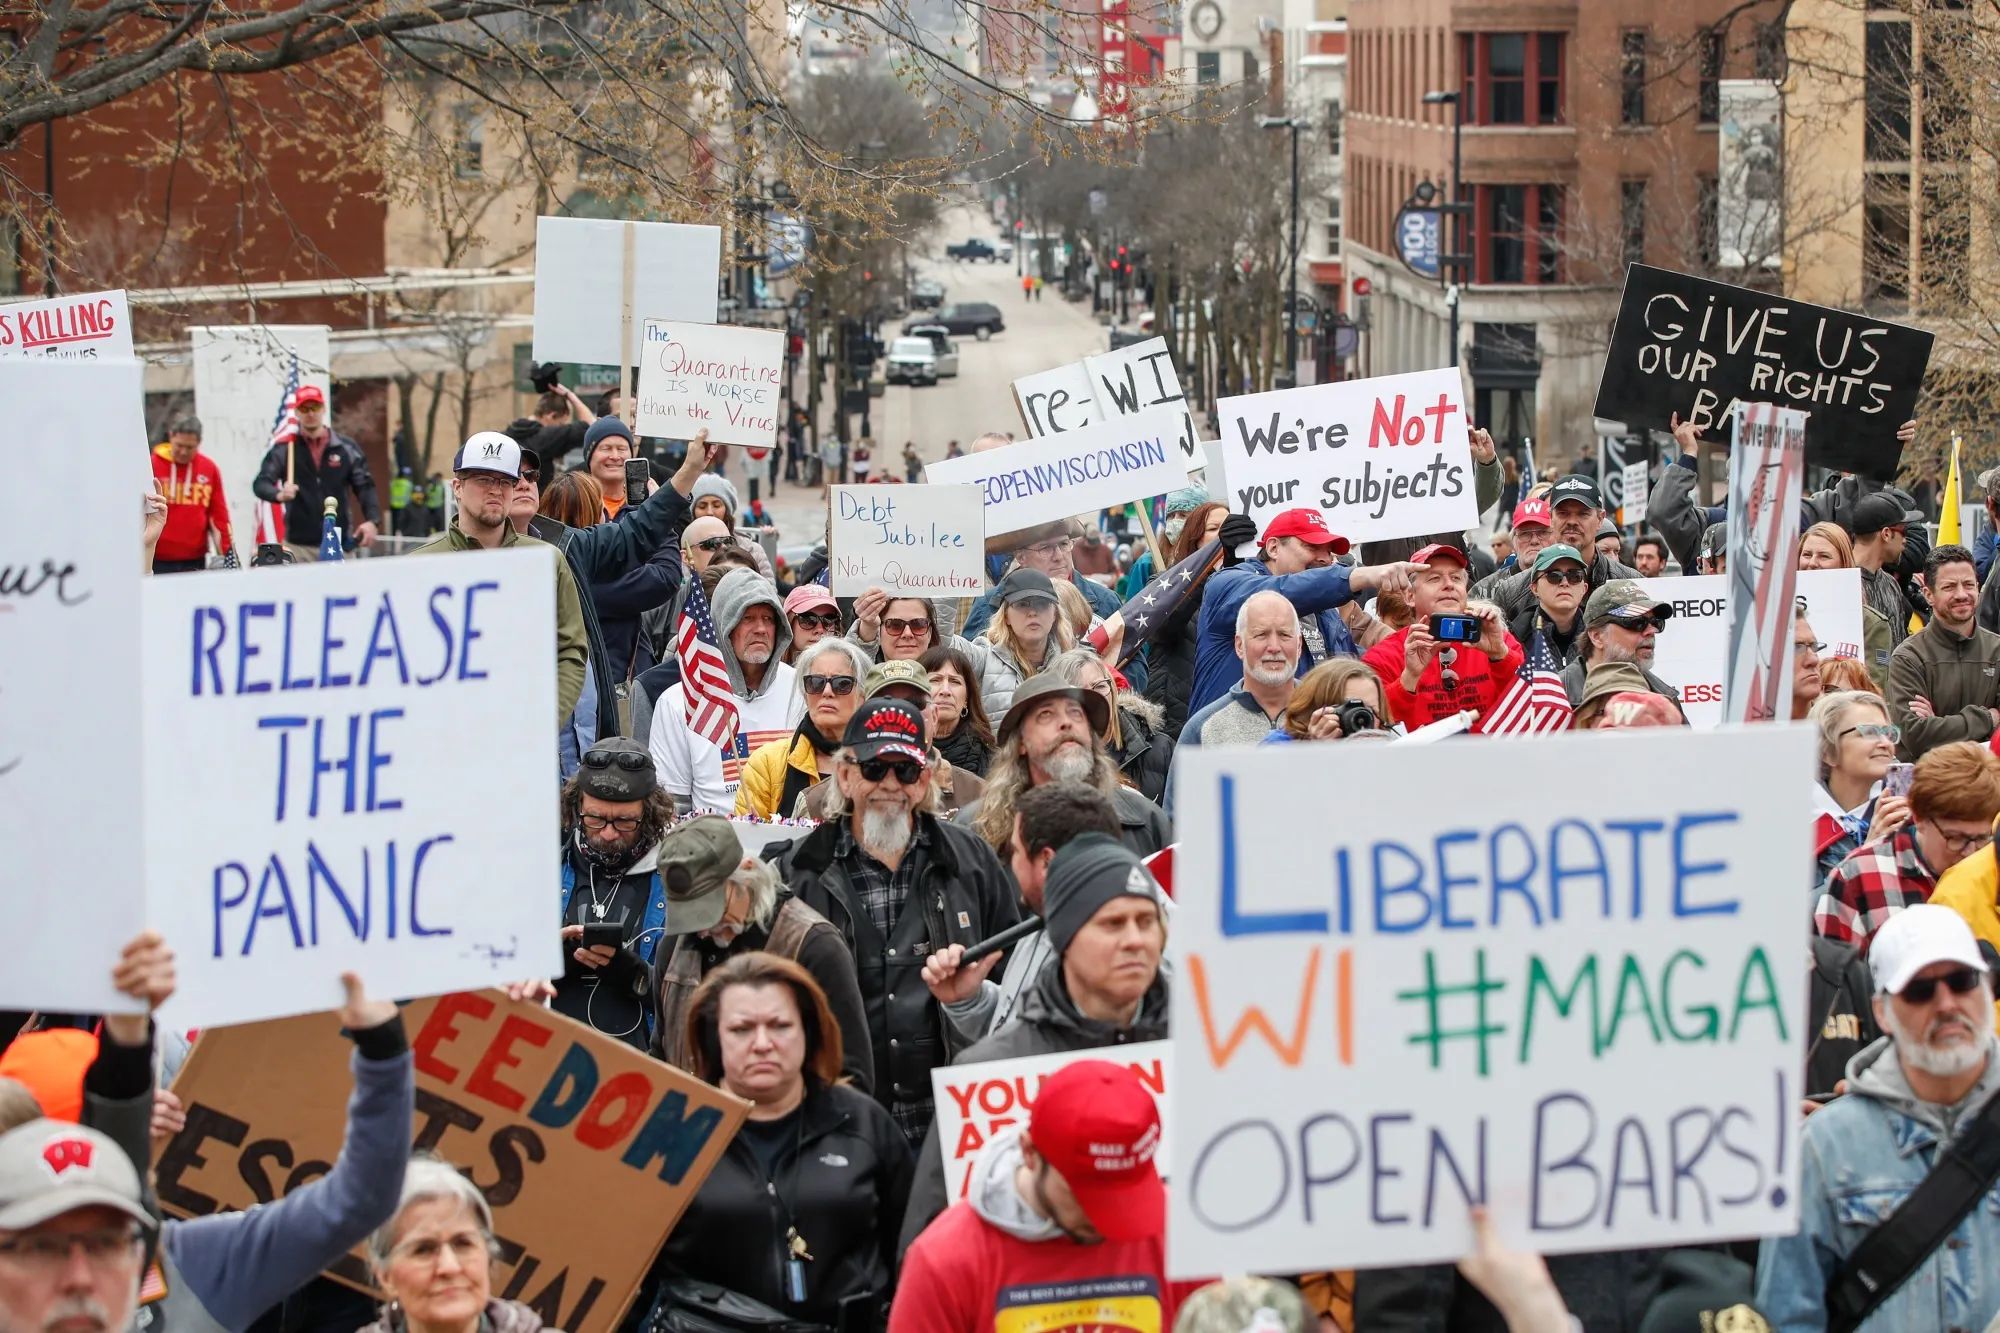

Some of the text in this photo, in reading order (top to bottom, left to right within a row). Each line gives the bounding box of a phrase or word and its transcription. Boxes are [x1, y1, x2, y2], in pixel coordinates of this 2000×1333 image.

[17, 299, 115, 343] KILLING
[647, 325, 670, 342] The
[659, 342, 780, 384] Quarantine
[1638, 343, 1717, 383] OUR
[1816, 317, 1889, 376] US
[665, 379, 768, 404] IS WORSE
[642, 396, 775, 432] than the Virus
[1236, 412, 1349, 458] We're
[1368, 393, 1458, 449] Not
[839, 490, 897, 522] Debt
[1237, 452, 1464, 520] your subjects
[1523, 502, 1543, 515] W
[875, 520, 966, 549] Jubilee
[837, 555, 983, 590] Not Quarantine
[191, 582, 500, 697] RELEASE
[864, 710, 919, 735] TRUMP
[1611, 701, 1645, 725] W
[257, 708, 406, 822] THE
[1218, 771, 1741, 938] LIBERATE
[212, 834, 455, 959] PANIC
[1187, 945, 1789, 1077] WI #MAGA
[1190, 1068, 1790, 1233] OPEN BARS!
